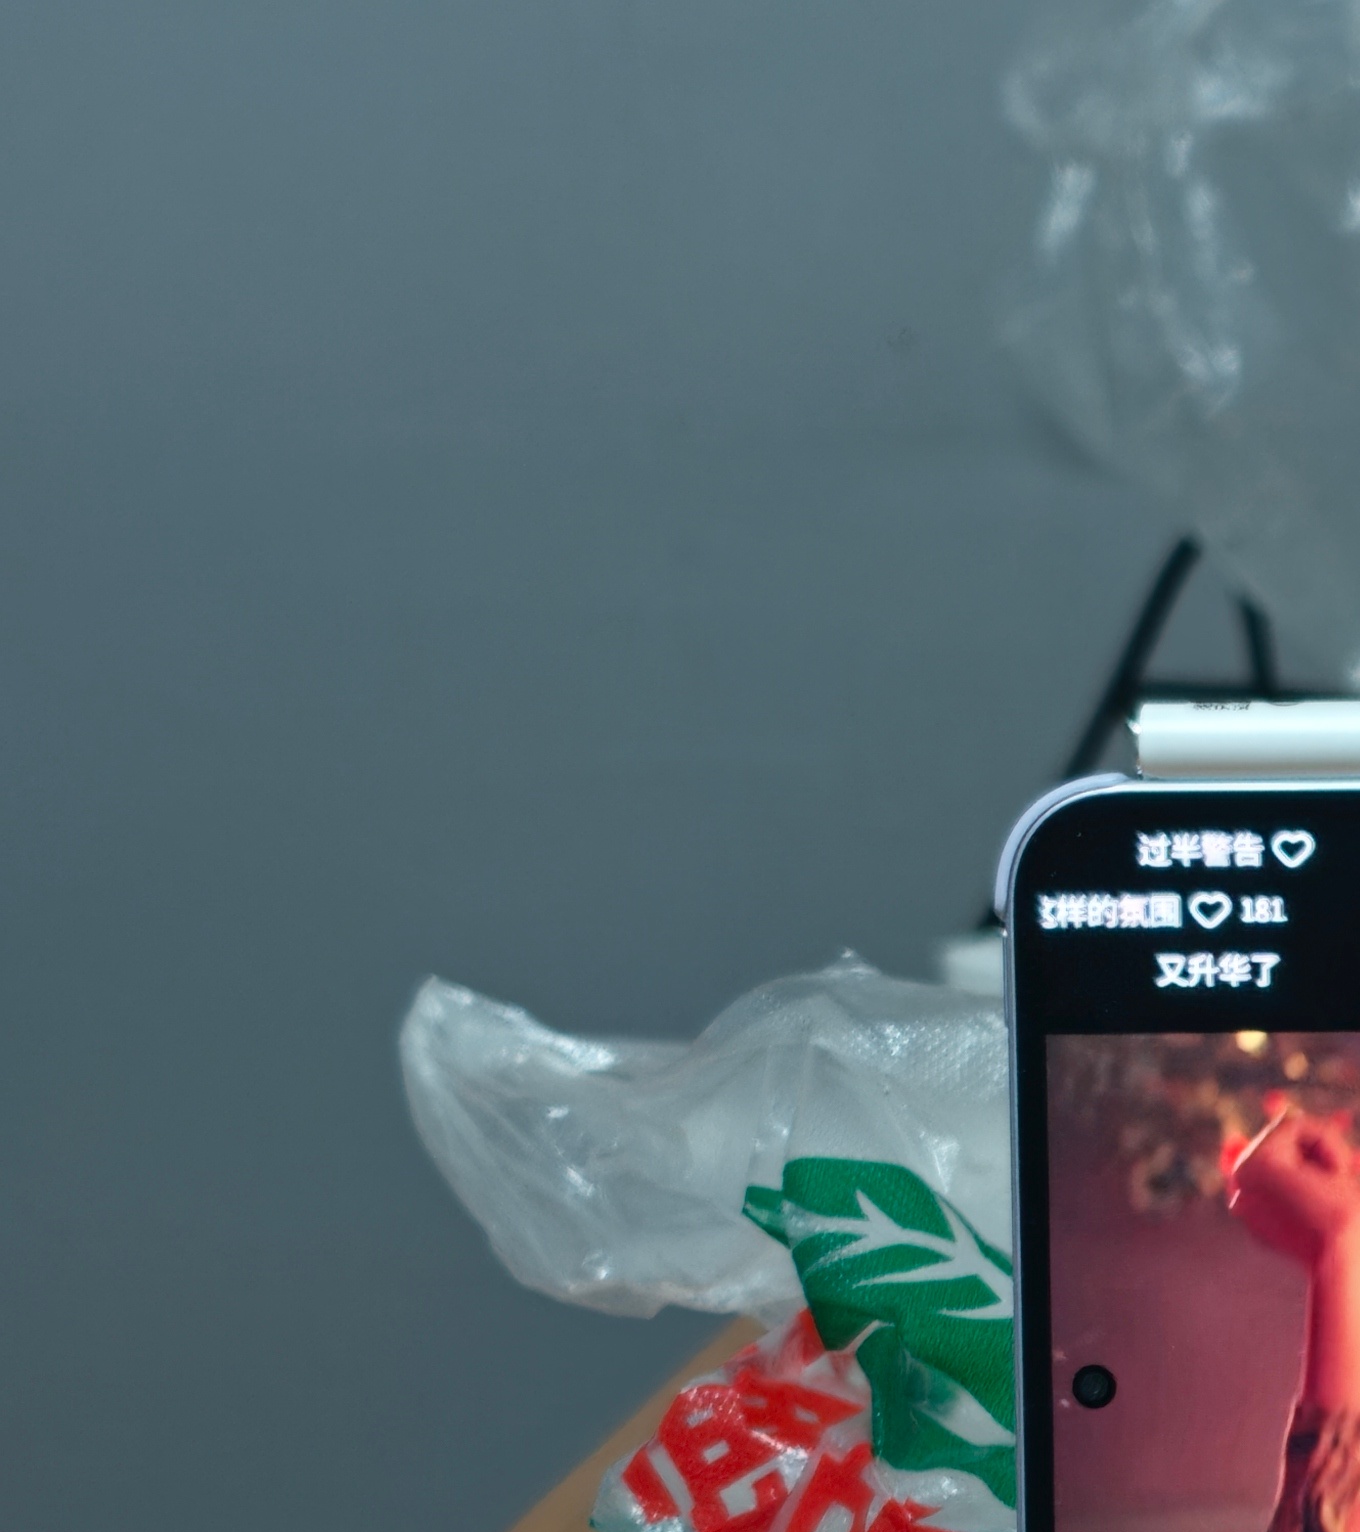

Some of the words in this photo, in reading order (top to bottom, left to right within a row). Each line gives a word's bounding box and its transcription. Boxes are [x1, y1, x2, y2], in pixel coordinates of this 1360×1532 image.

[1137, 830, 1265, 867] 过半警告
[1240, 895, 1288, 923] 181
[1156, 952, 1280, 987] 又升华了
